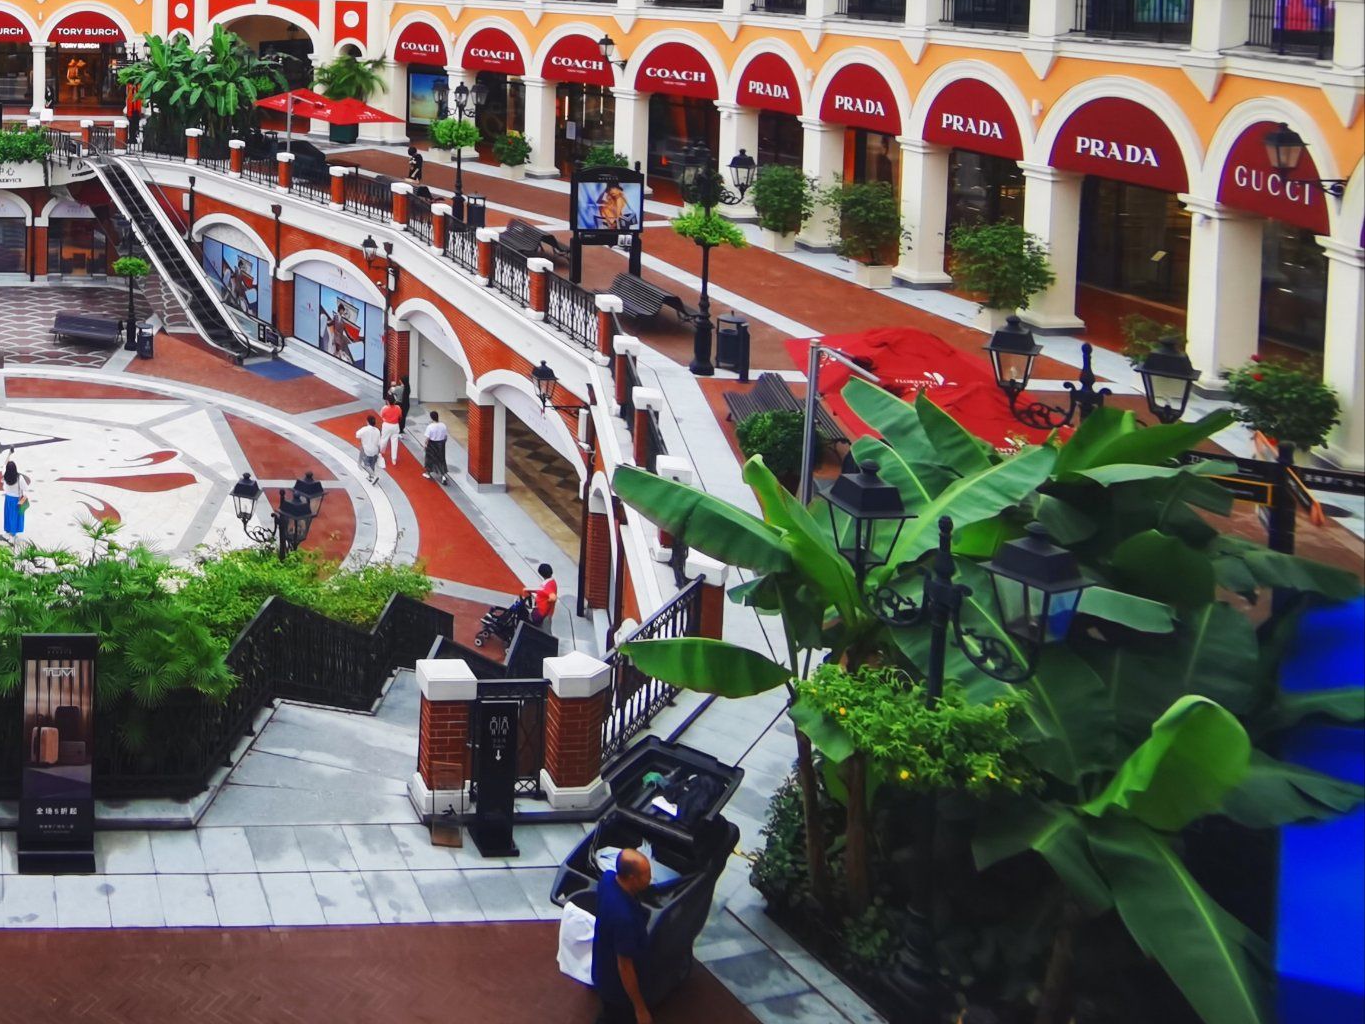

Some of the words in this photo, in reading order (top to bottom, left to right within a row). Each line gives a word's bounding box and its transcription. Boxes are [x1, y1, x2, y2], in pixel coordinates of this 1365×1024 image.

[56, 28, 82, 36] TORY
[84, 28, 119, 36] BURCH
[401, 42, 439, 53] COACH
[470, 48, 515, 61] COACH
[551, 56, 603, 71] COACH
[645, 67, 706, 82] COACH
[749, 80, 790, 99] PRADA
[835, 95, 885, 116] PRADA
[941, 112, 1003, 140] PRADA
[1075, 136, 1159, 168] PRADA
[1234, 165, 1310, 206] GUCCI
[42, 666, 76, 677] TUMI
